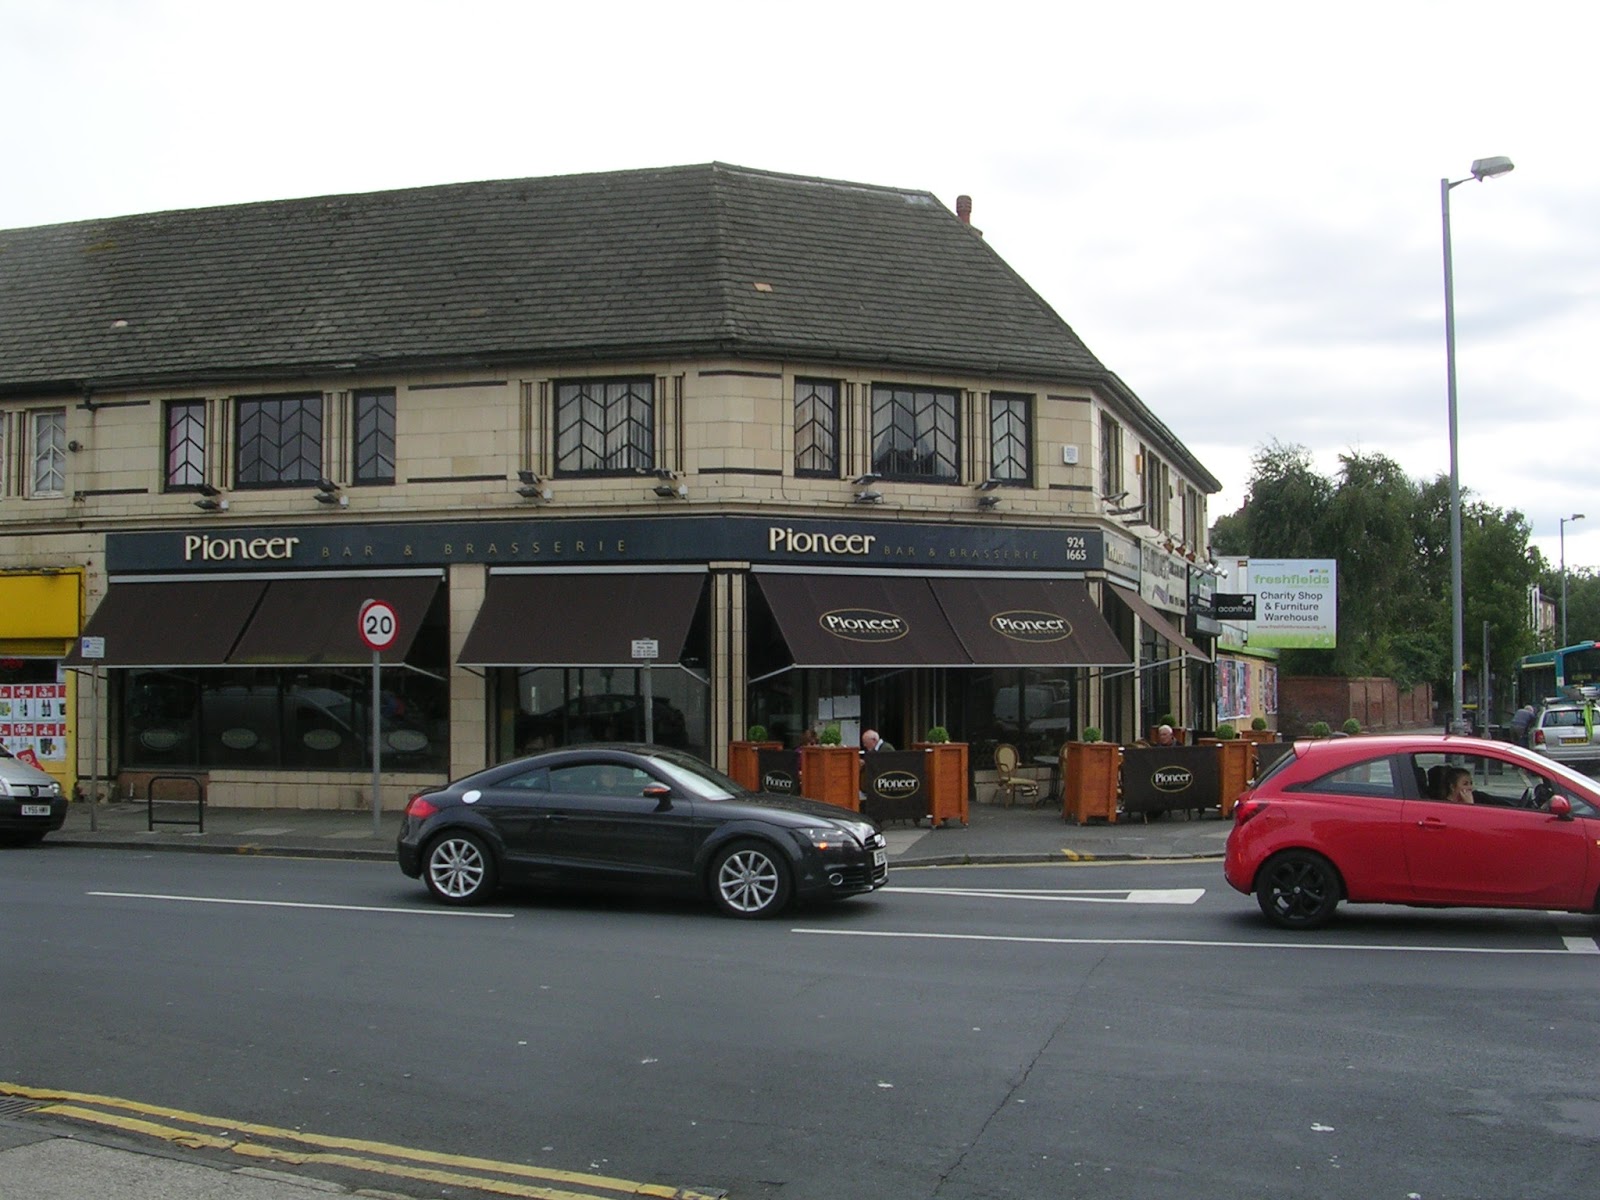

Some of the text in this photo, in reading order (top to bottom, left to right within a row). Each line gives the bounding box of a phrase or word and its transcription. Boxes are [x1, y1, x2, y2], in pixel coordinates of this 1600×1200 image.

[769, 527, 876, 555] Pioneer
[1066, 536, 1085, 548] 924
[185, 535, 299, 560] Pioneer
[322, 540, 625, 558] BAR & BRASSERIE
[884, 545, 1039, 560] BAR & BRASSERIE
[1066, 549, 1087, 560] 1665
[1255, 574, 1329, 584] freshfields
[1260, 591, 1323, 601] Charity Shop
[1218, 605, 1253, 613] acanthus
[1264, 602, 1319, 611] & Furniture
[826, 615, 901, 629] Pioneer
[1264, 613, 1319, 621] Warehouse
[366, 615, 392, 634] 20
[996, 617, 1064, 630] Pioneer
[765, 775, 792, 788] Pioneer
[878, 778, 916, 788] Pioneer
[1155, 773, 1190, 782] Pioneer
